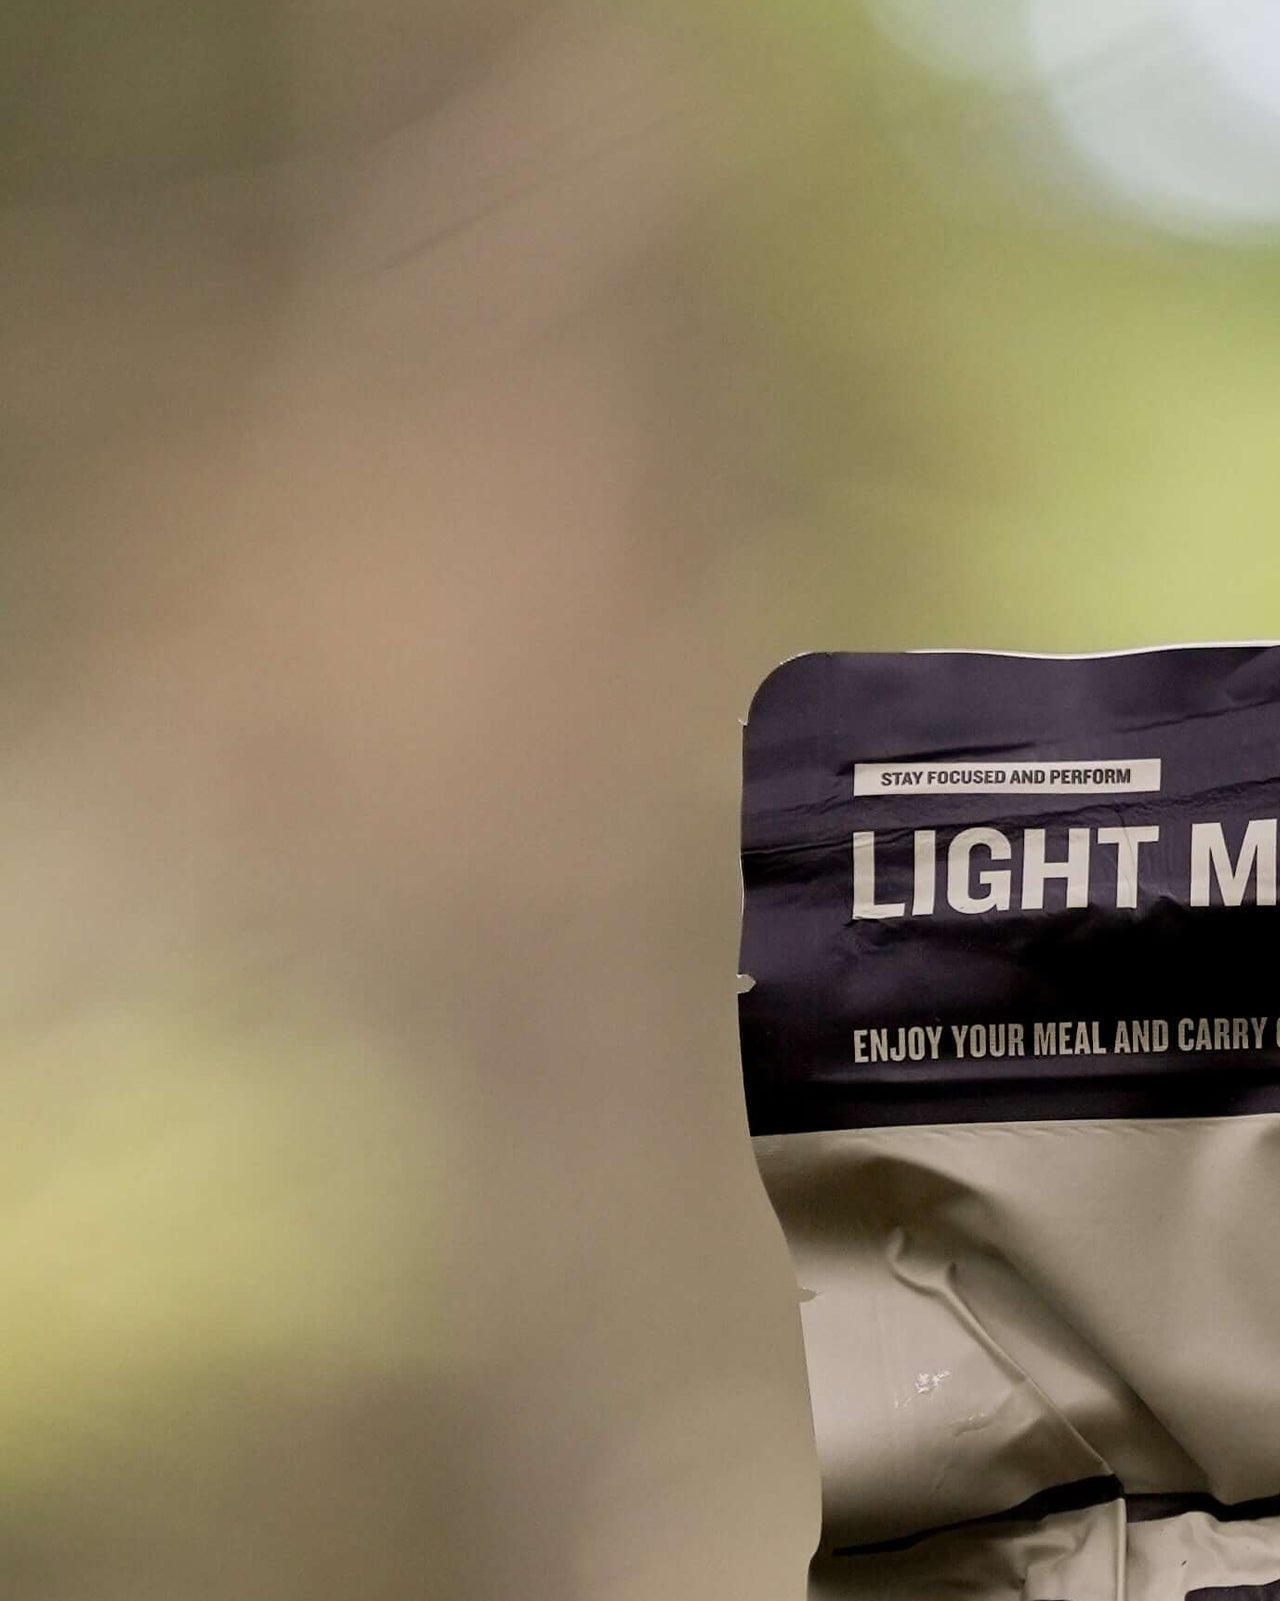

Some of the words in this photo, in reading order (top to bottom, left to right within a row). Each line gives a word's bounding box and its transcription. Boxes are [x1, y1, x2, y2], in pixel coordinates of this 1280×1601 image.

[880, 770, 923, 787] STAY
[926, 769, 1006, 786] FOCUSED
[1009, 769, 1046, 785] AND
[1049, 768, 1131, 785] PERFORM
[852, 825, 1160, 920] LIGHT
[853, 1026, 943, 1064] ENJOY
[951, 1023, 1025, 1058] YOUR
[1033, 1021, 1106, 1056] MEAL
[1113, 1019, 1168, 1054] AND
[1177, 1017, 1268, 1052] CARRY
